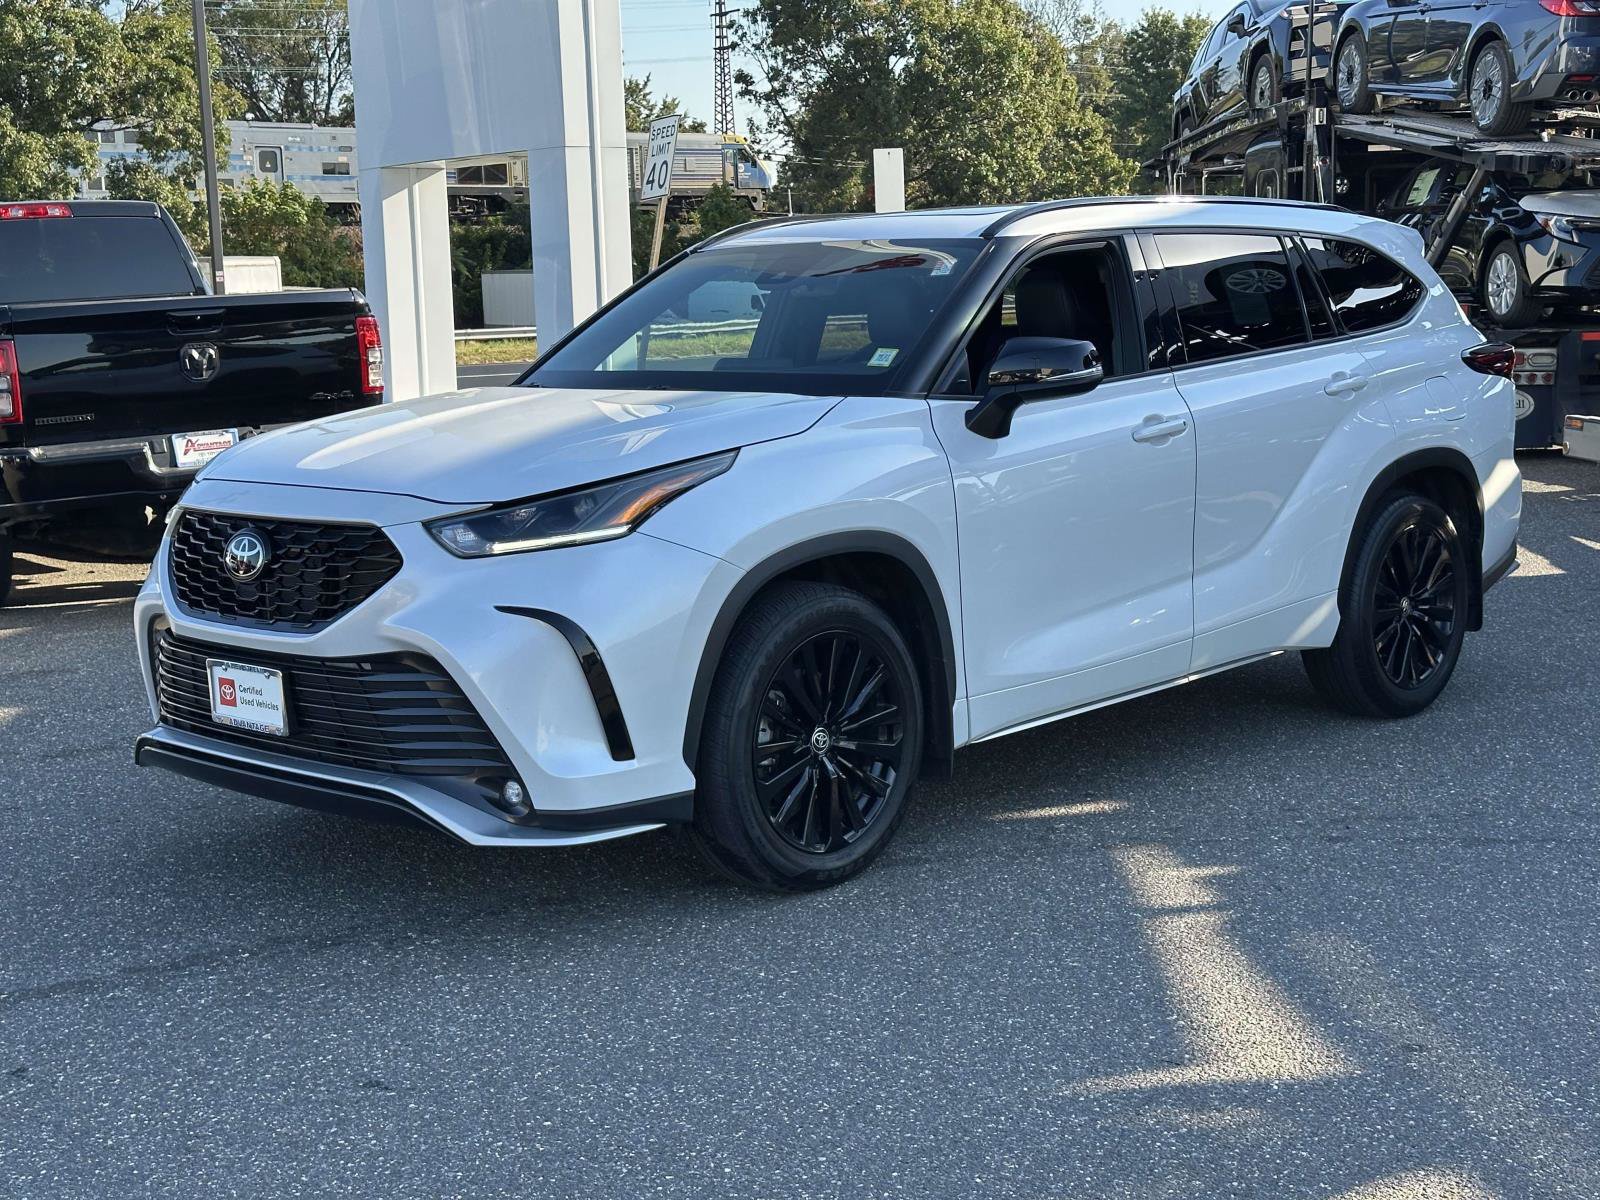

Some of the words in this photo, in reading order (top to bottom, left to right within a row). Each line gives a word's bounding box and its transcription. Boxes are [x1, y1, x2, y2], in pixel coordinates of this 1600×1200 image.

[651, 124, 676, 141] SPEED
[651, 141, 671, 157] LIMIT
[646, 160, 669, 191] 40
[238, 684, 263, 696] Certified
[239, 697, 255, 707] Used
[255, 699, 279, 711] Vehicles
[229, 718, 270, 733] ADVANTAGE
